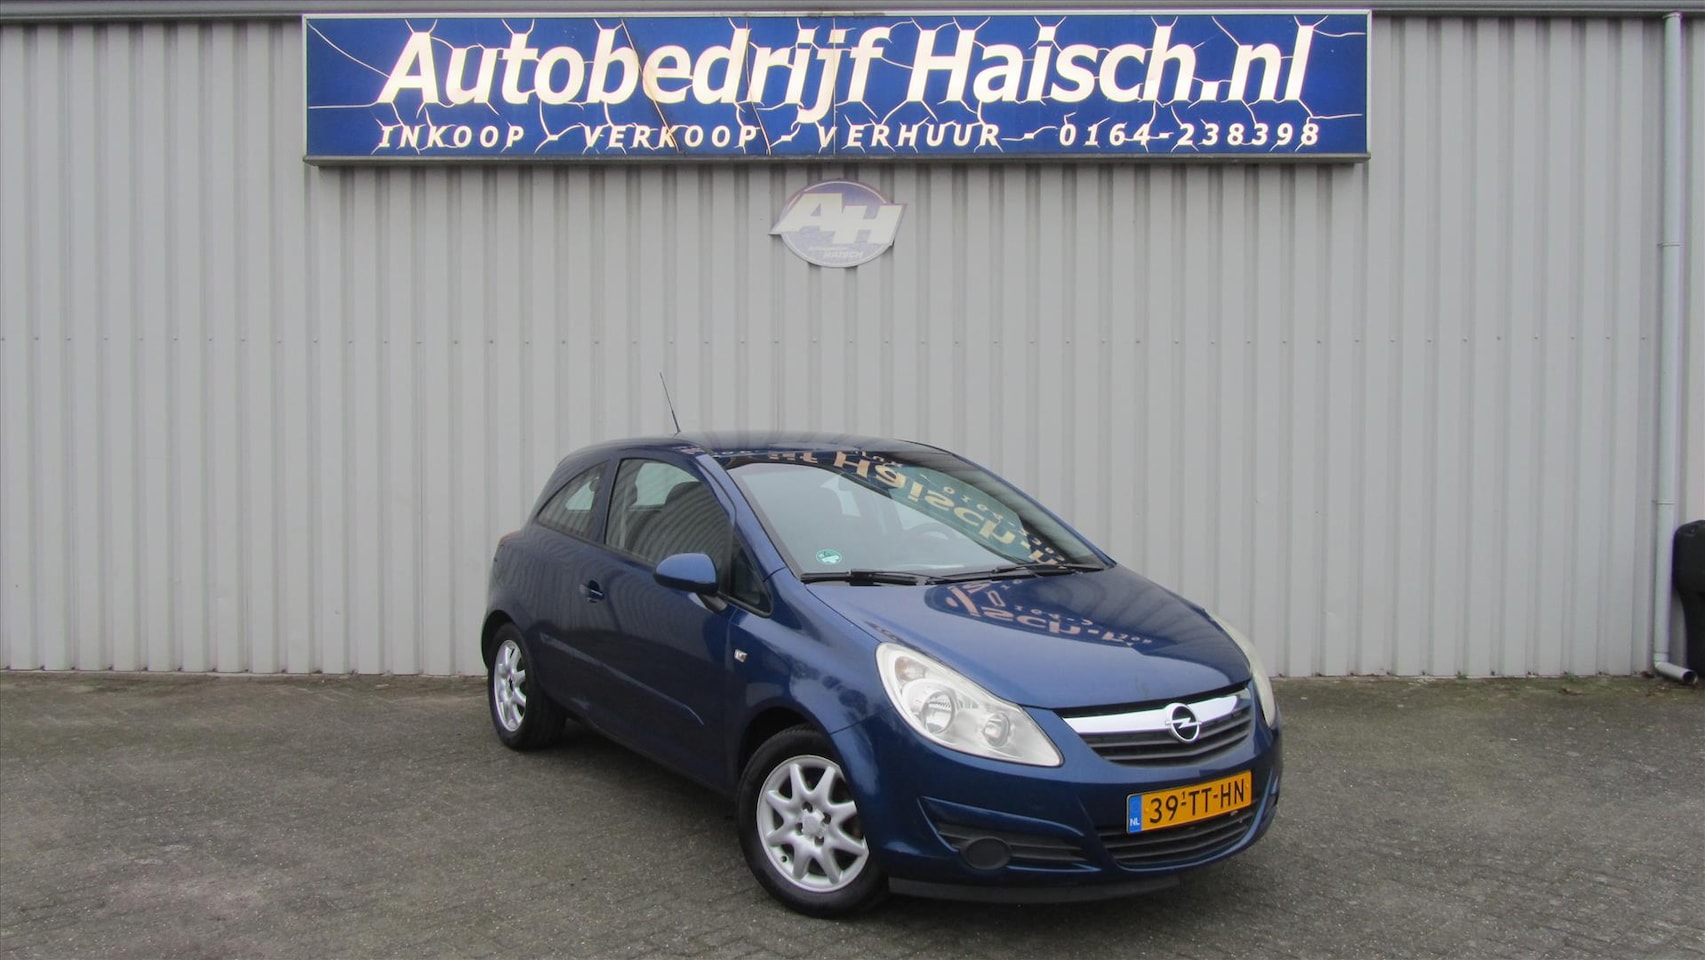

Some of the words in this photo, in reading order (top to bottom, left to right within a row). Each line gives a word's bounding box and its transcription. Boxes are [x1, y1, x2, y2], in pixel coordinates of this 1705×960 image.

[376, 27, 892, 123] Autobedrijf
[907, 26, 1316, 105] Haisch.nl
[379, 125, 524, 148] INKOOP
[584, 125, 758, 149] VERKOOP
[817, 124, 1000, 148] VERHUUR
[1059, 123, 1320, 147] 0164-238398
[769, 192, 903, 244] AH
[1130, 818, 1141, 826] NL
[1150, 779, 1245, 823] 39-TT-HN
